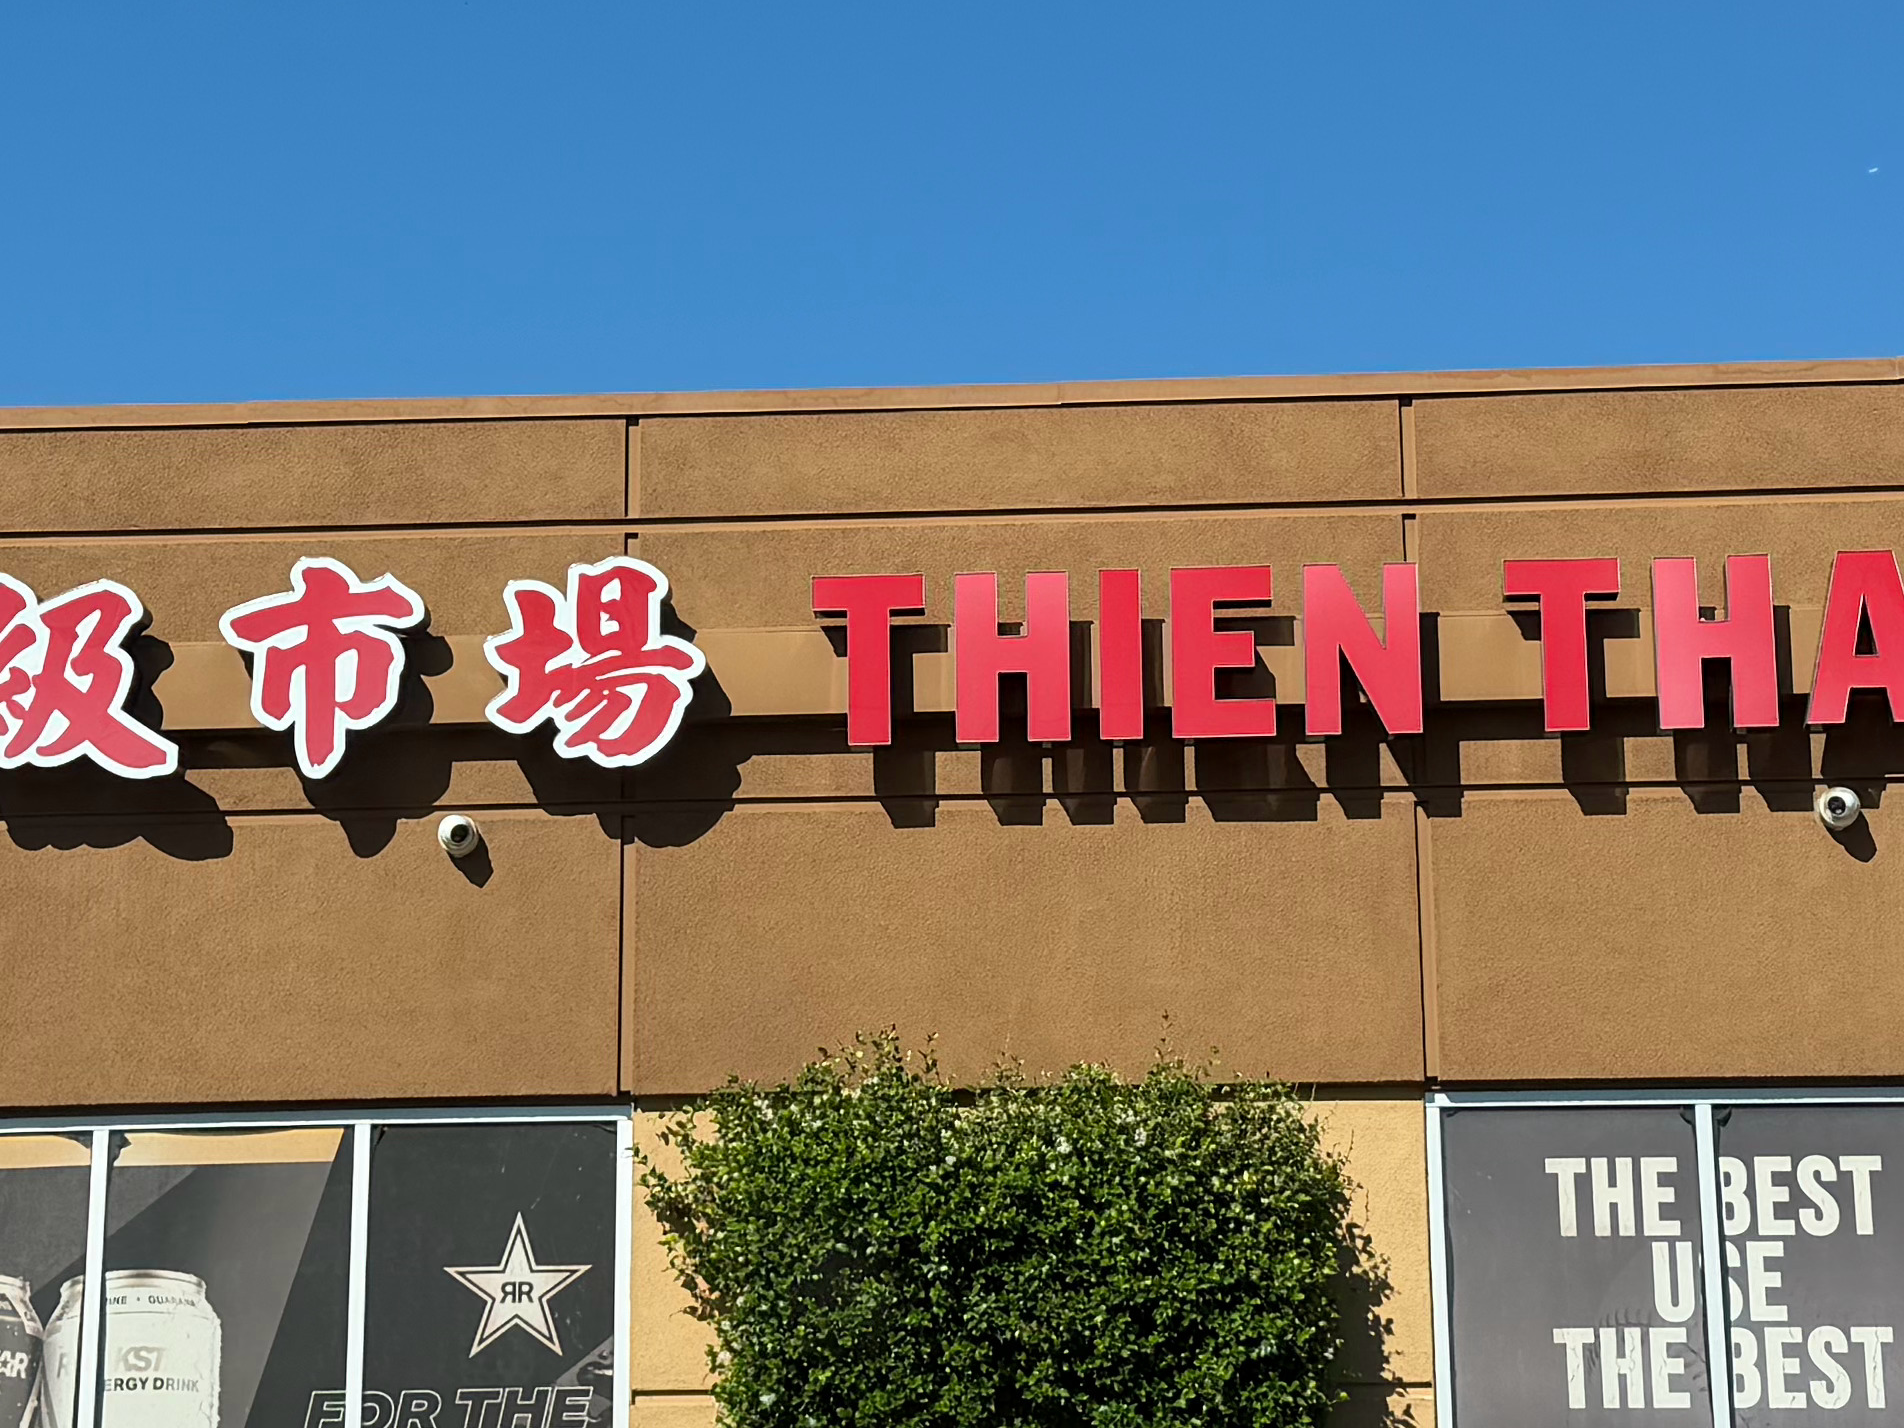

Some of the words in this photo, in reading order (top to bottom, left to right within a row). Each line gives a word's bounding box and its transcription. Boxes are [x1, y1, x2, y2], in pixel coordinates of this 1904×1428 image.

[811, 562, 1423, 745] THIEN
[1545, 1157, 1681, 1236] THE
[1718, 1154, 1882, 1235] BEST
[153, 1377, 199, 1392] DRINK
[1553, 1327, 1690, 1409] THE
[1730, 1325, 1893, 1409] BEST
